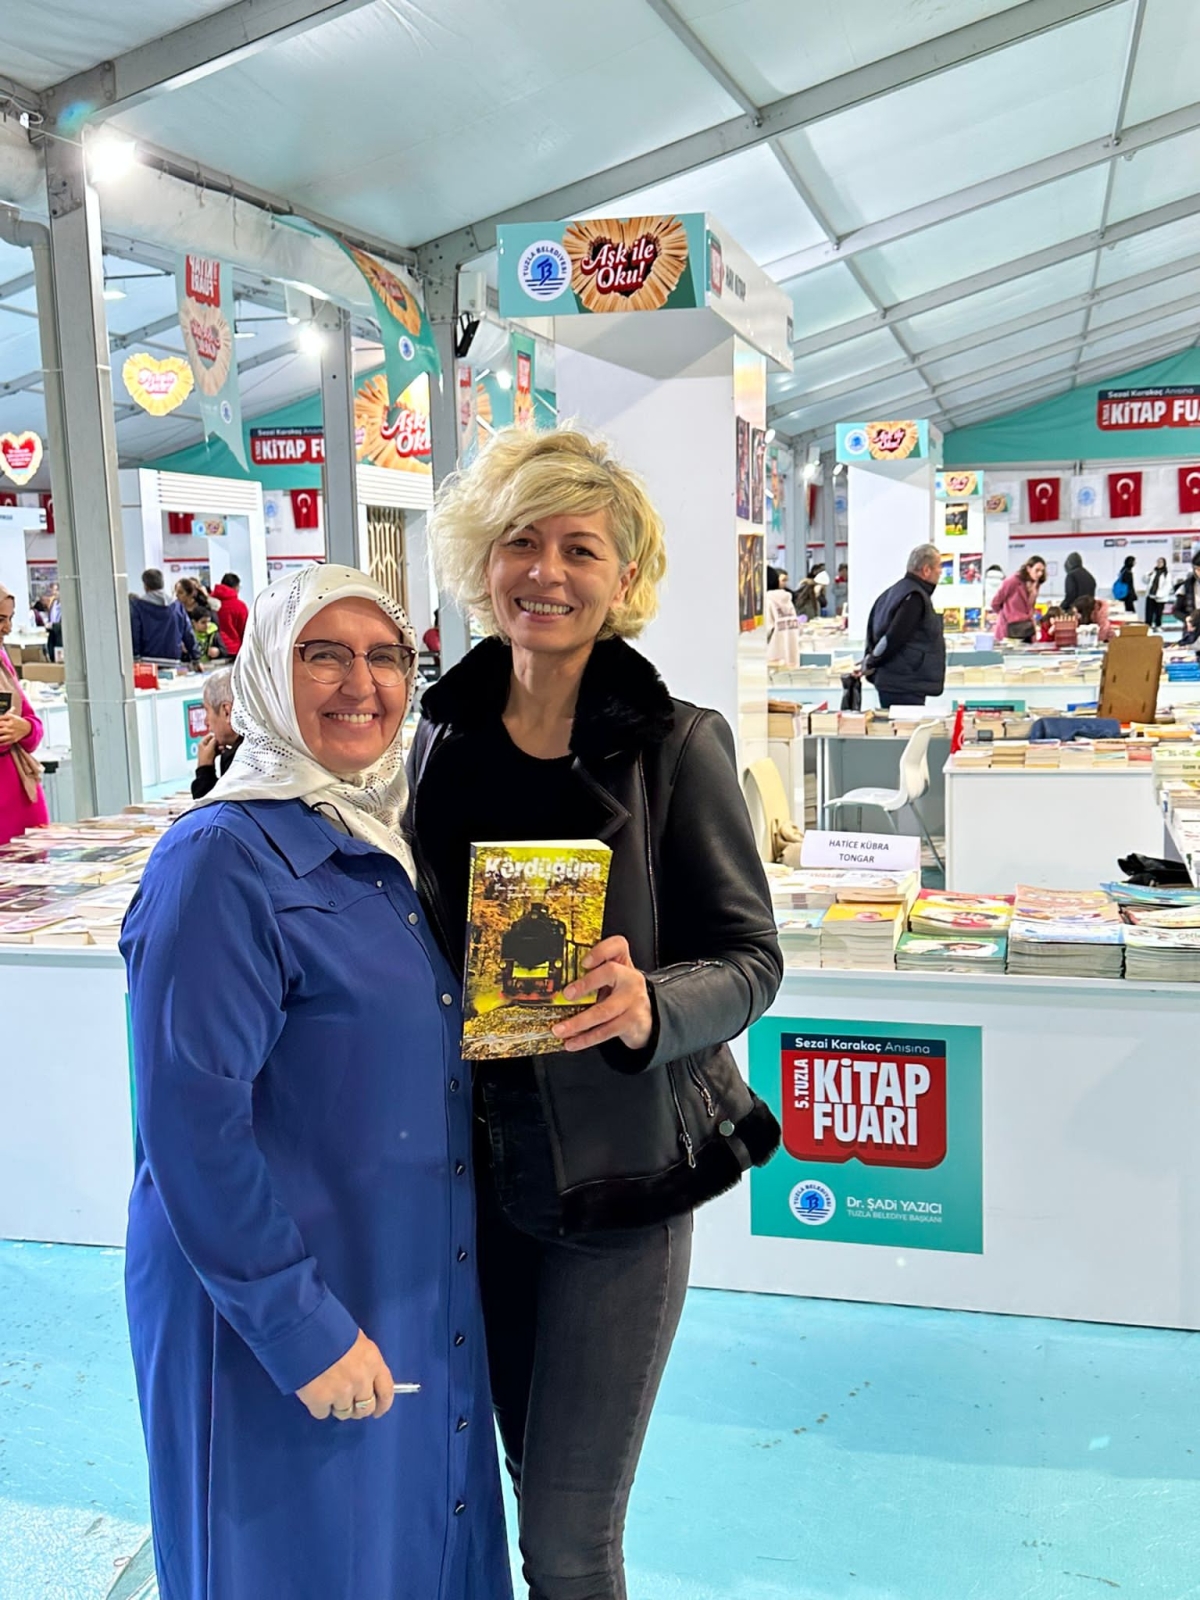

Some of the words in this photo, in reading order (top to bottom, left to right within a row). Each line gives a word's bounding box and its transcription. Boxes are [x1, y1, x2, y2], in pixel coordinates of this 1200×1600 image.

[582, 242, 627, 270] Aşk
[632, 238, 654, 260] ile
[597, 261, 645, 289] Oku!
[1110, 401, 1167, 425] KİTAP
[1172, 399, 1200, 422] FU
[262, 439, 306, 460] KİTAP
[829, 839, 858, 849] HATİCE
[860, 841, 889, 851] KÜBRA
[839, 853, 875, 863] TONGAR
[795, 1037, 828, 1049] Sezai
[831, 1039, 882, 1053] Karakoç
[884, 1042, 931, 1054] Anısına
[813, 1058, 931, 1107] KİTAP
[813, 1102, 918, 1146] FUARI
[846, 1196, 865, 1209] Dr.
[900, 1200, 942, 1214] YAZICI
[847, 1209, 871, 1218] TUZLA
